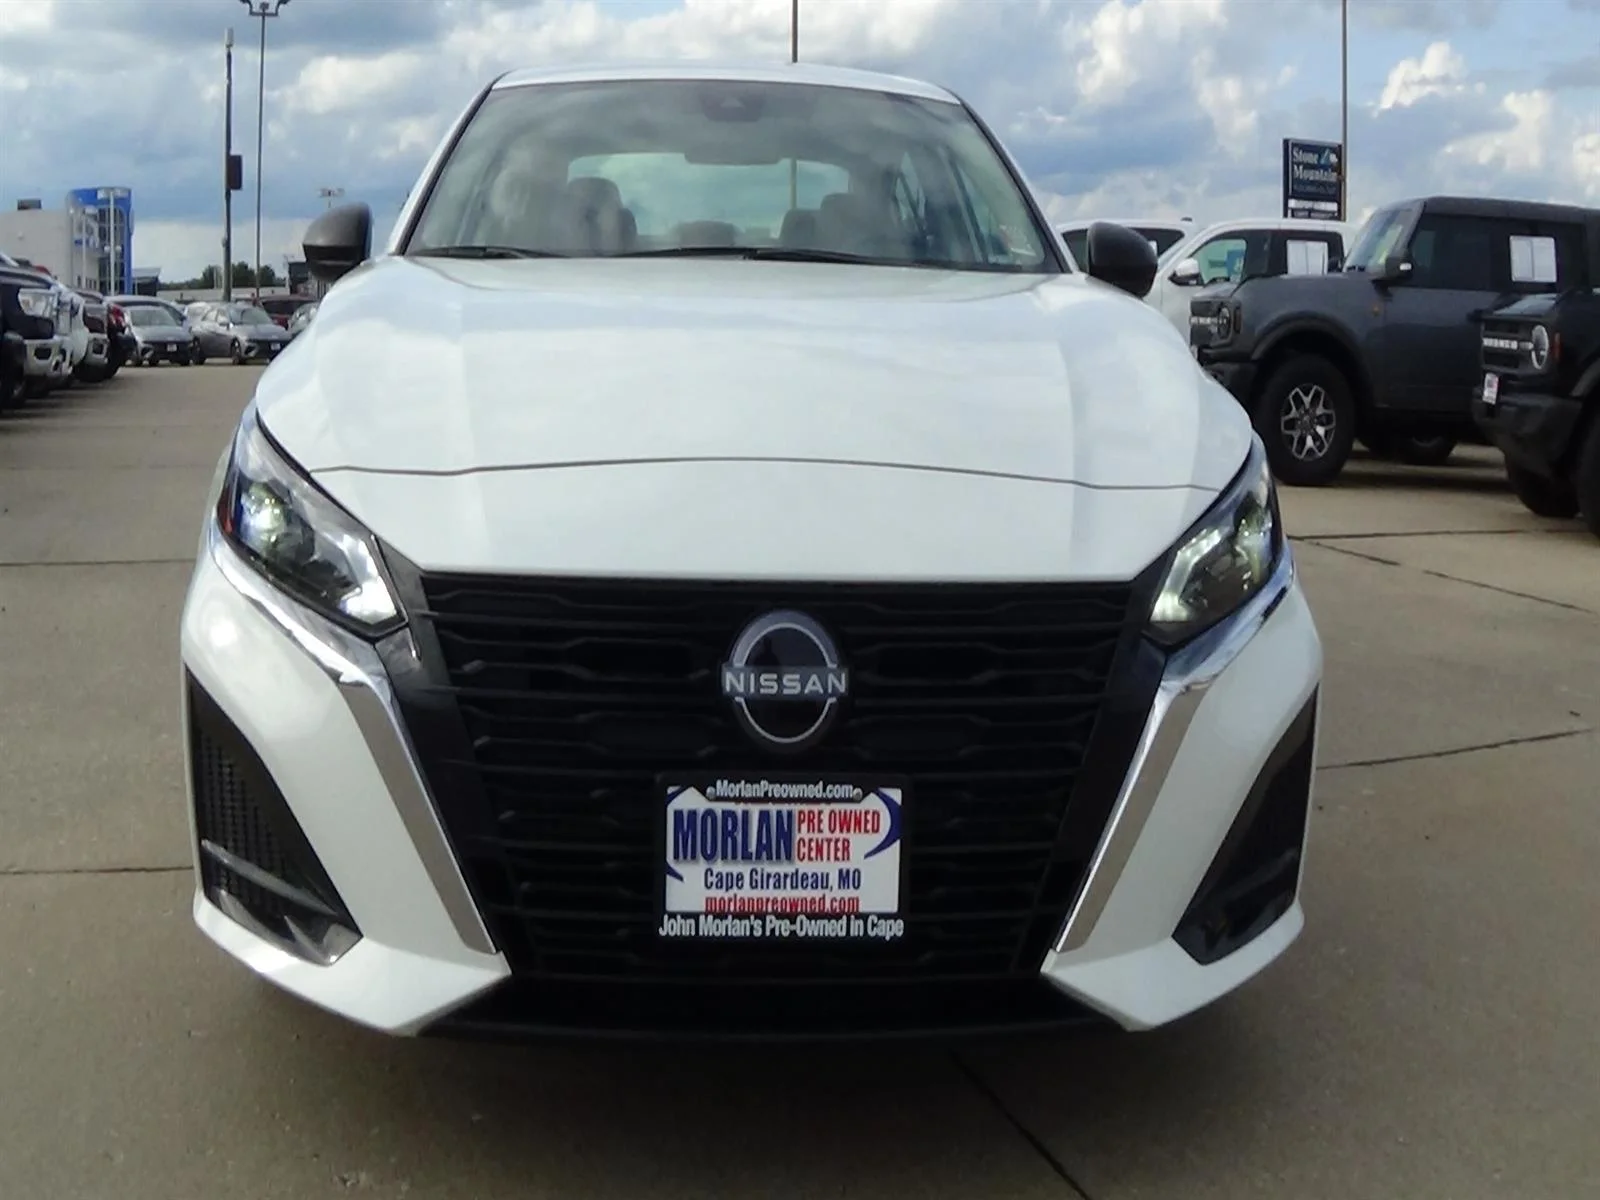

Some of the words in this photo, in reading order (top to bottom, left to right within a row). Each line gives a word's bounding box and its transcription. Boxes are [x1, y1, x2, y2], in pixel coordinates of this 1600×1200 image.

[725, 672, 846, 694] NISSAN
[715, 779, 854, 799] MorlanPreowned.com
[797, 809, 824, 834] PRE
[828, 809, 881, 834] OWNED
[672, 809, 793, 862] MORLAN
[796, 837, 851, 862] CENTER
[704, 868, 744, 892] Cape
[749, 868, 833, 891] Girardeau,
[838, 868, 862, 890] MO
[658, 915, 695, 937] John
[700, 915, 762, 937] Morlan's
[765, 915, 847, 937] Pre-Owned
[850, 915, 864, 937] in
[867, 915, 904, 941] Cape
